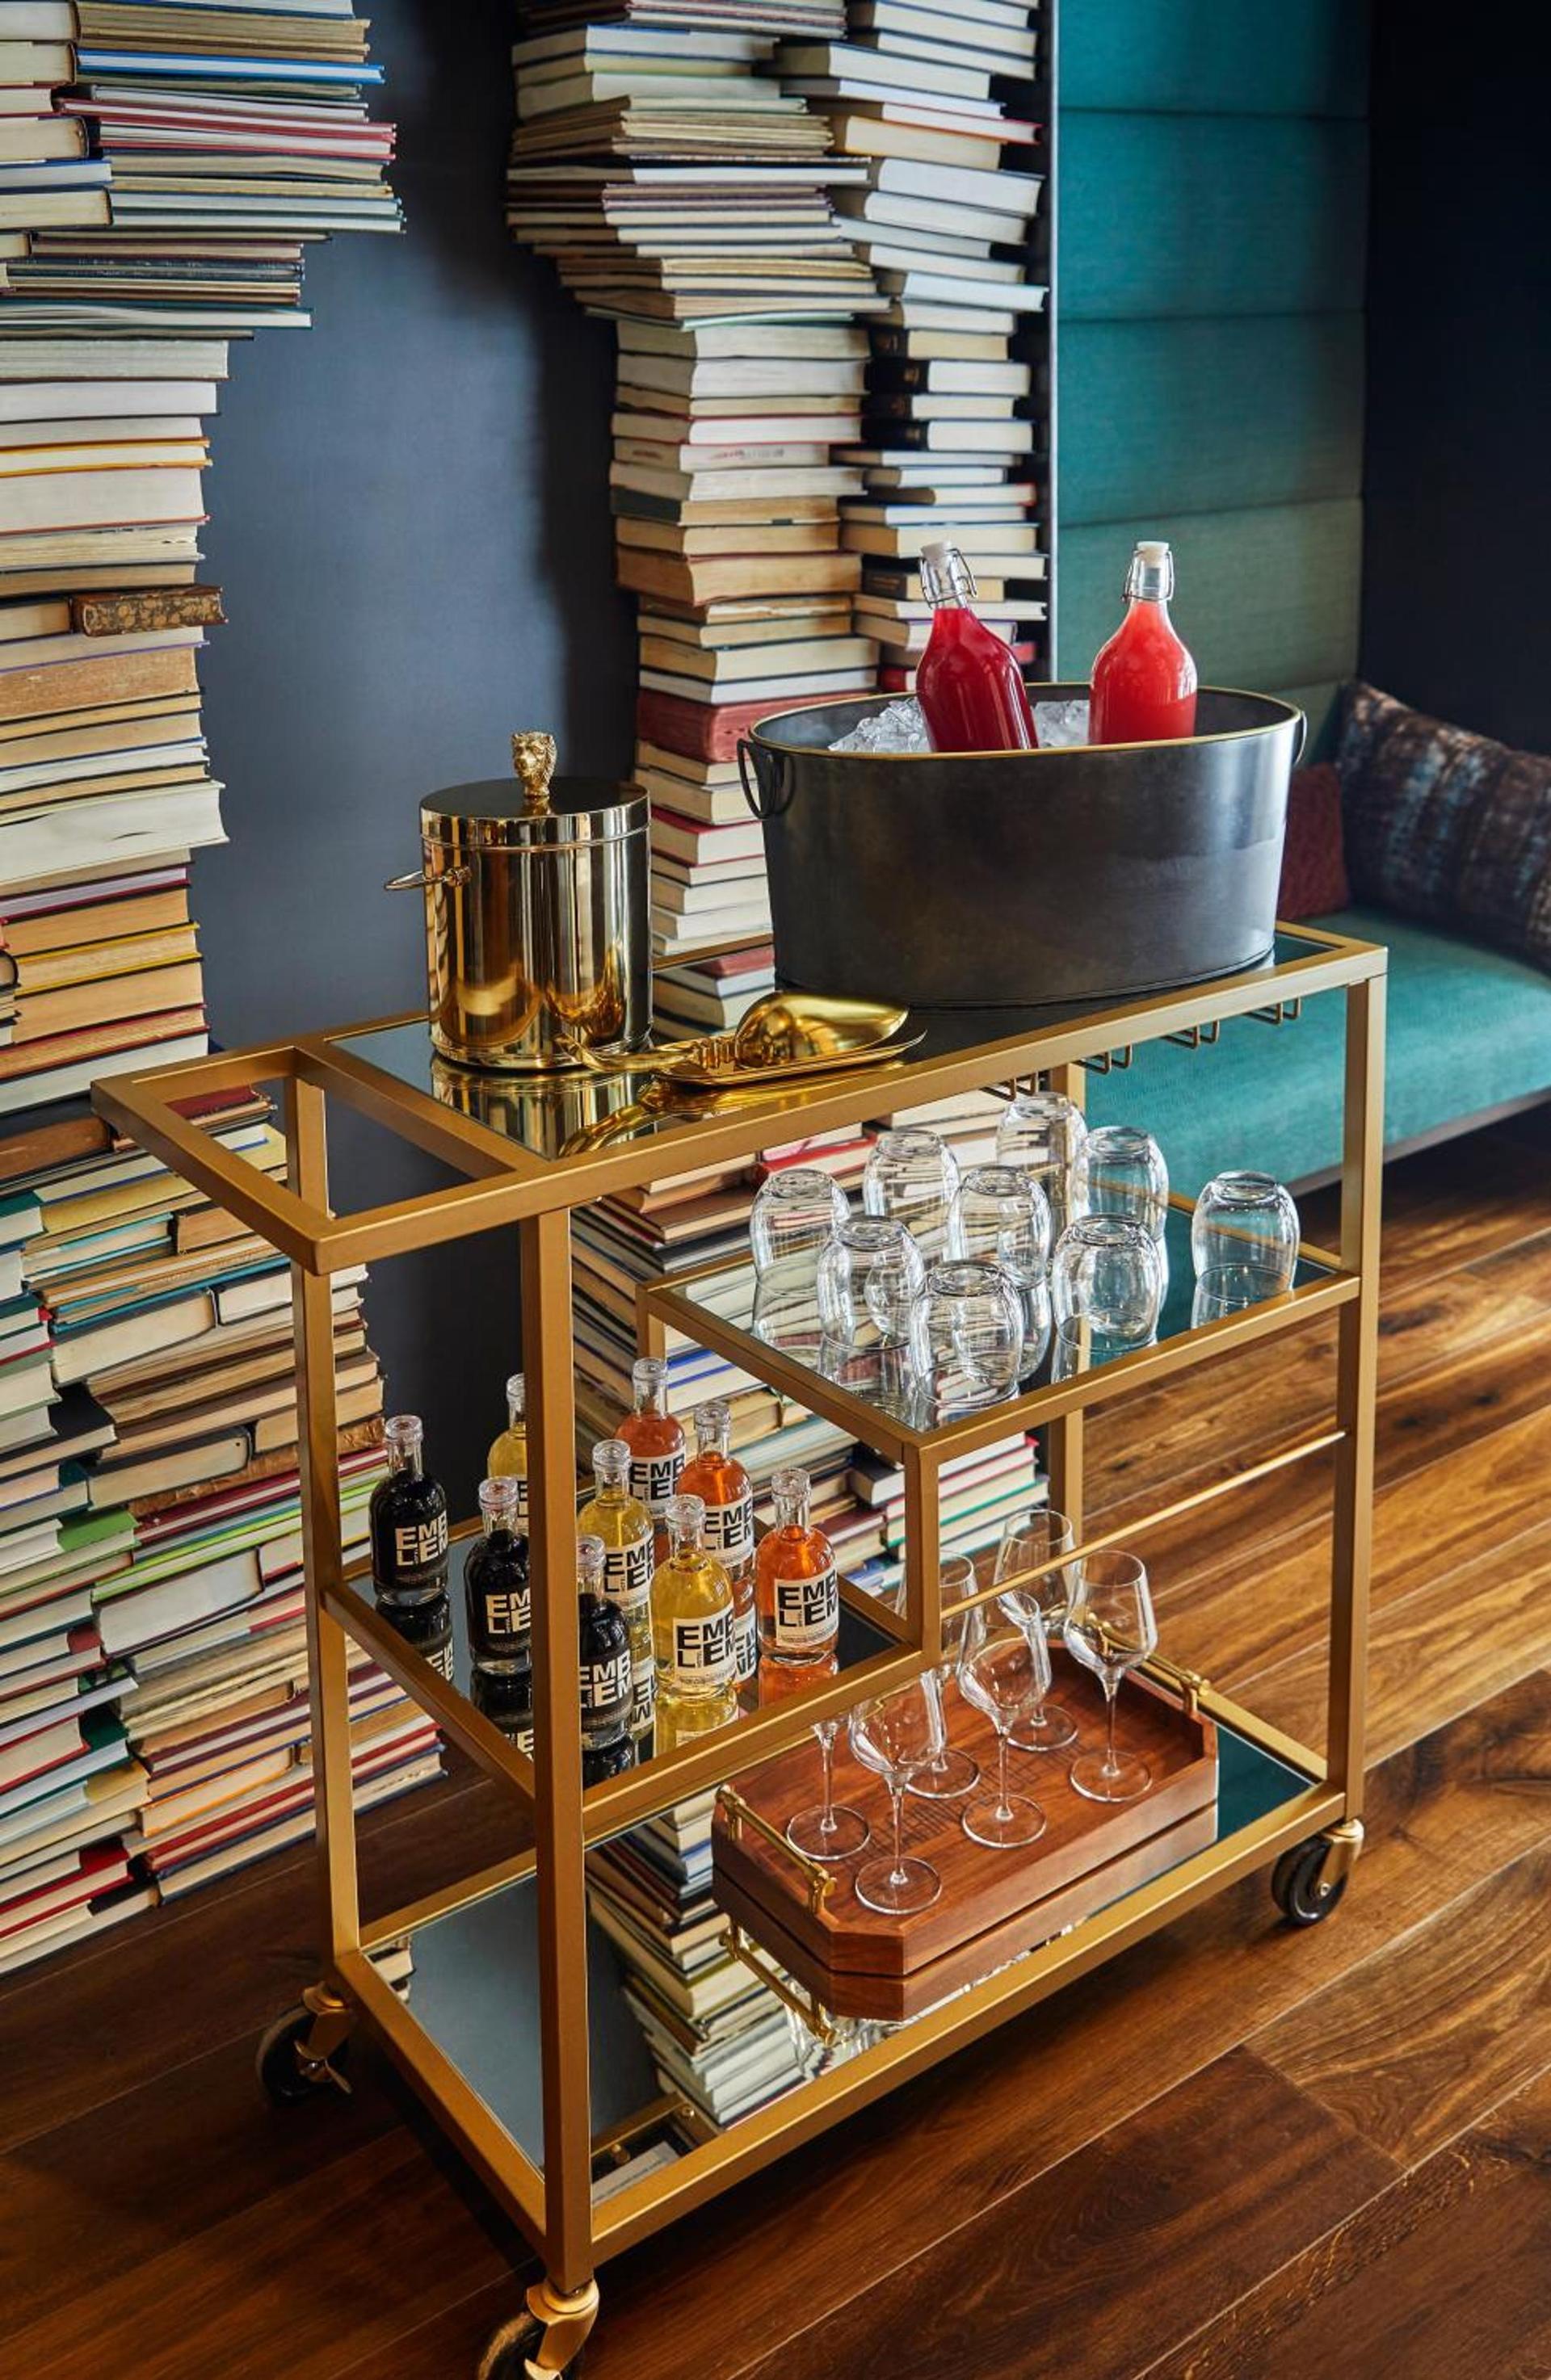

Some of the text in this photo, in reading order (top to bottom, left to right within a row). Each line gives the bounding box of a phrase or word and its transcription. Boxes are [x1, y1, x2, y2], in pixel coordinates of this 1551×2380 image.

[394, 1509, 448, 1550] EMB
[485, 1587, 532, 1617] EM
[777, 1568, 837, 1610] EMB
[486, 1606, 532, 1634] LE
[676, 1608, 734, 1650] EMB
